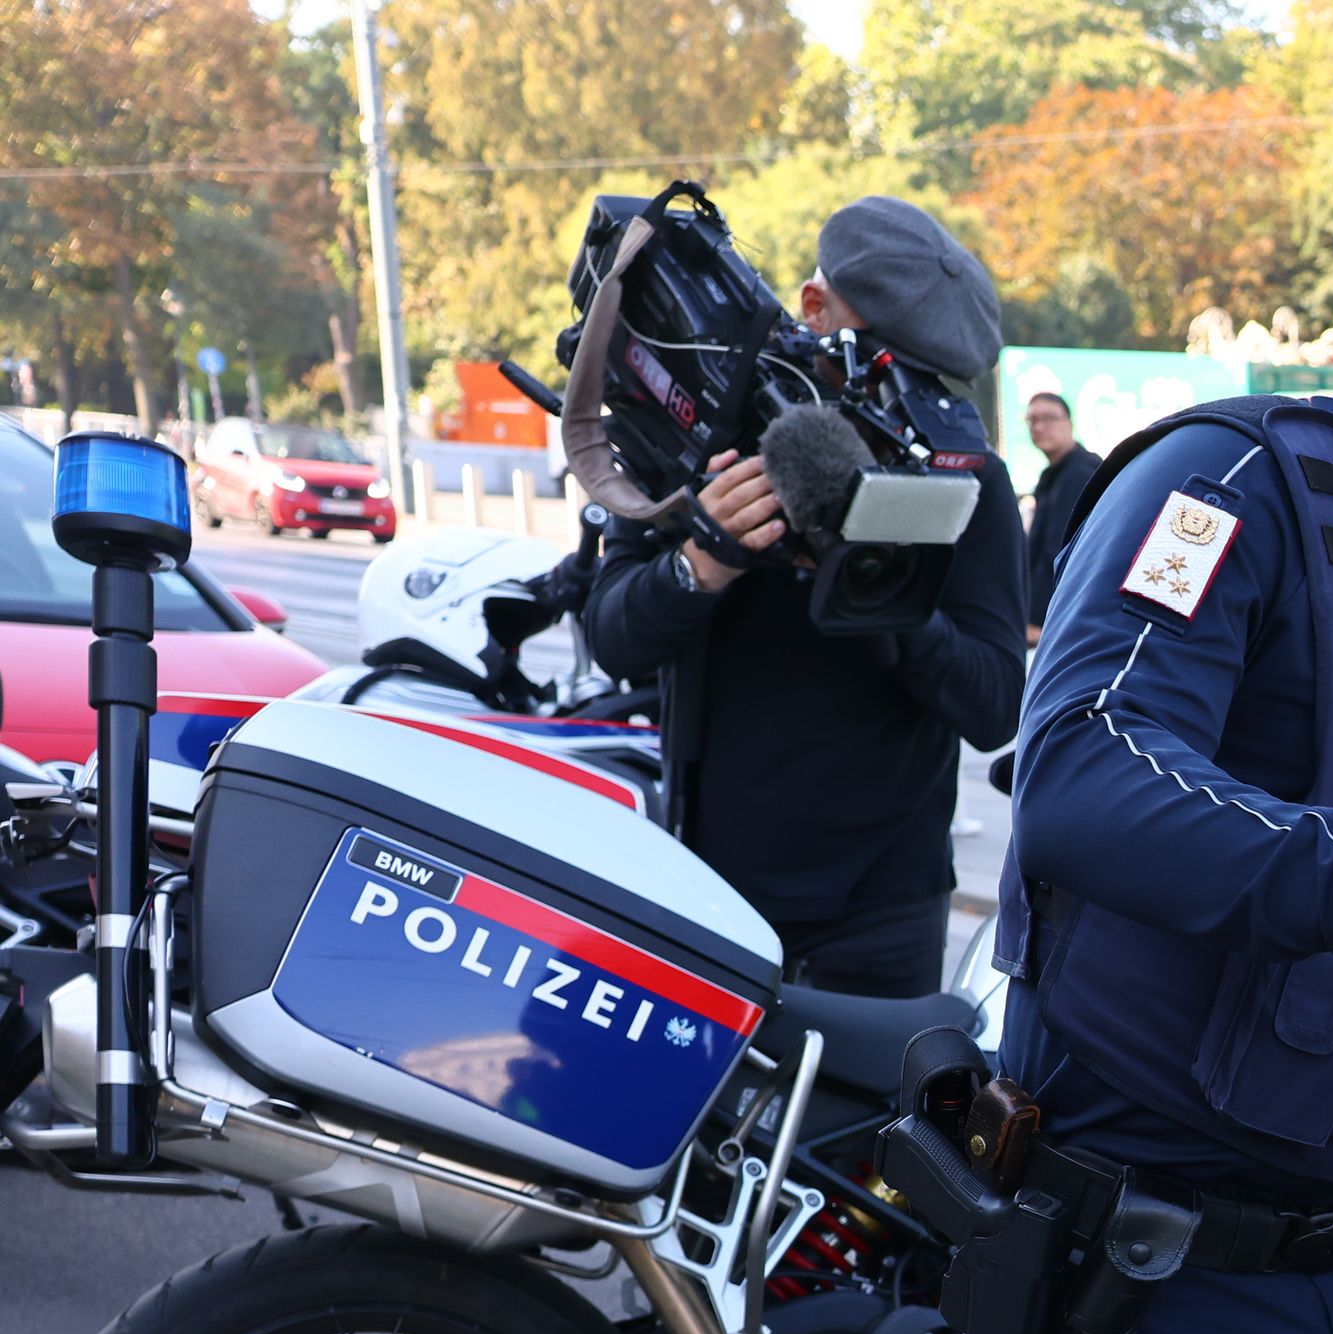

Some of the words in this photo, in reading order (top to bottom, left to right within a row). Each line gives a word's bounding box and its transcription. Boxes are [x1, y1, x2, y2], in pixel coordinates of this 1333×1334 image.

[669, 386, 696, 421] HD
[374, 850, 434, 886] BMW
[350, 880, 655, 1042] POLIZEI
